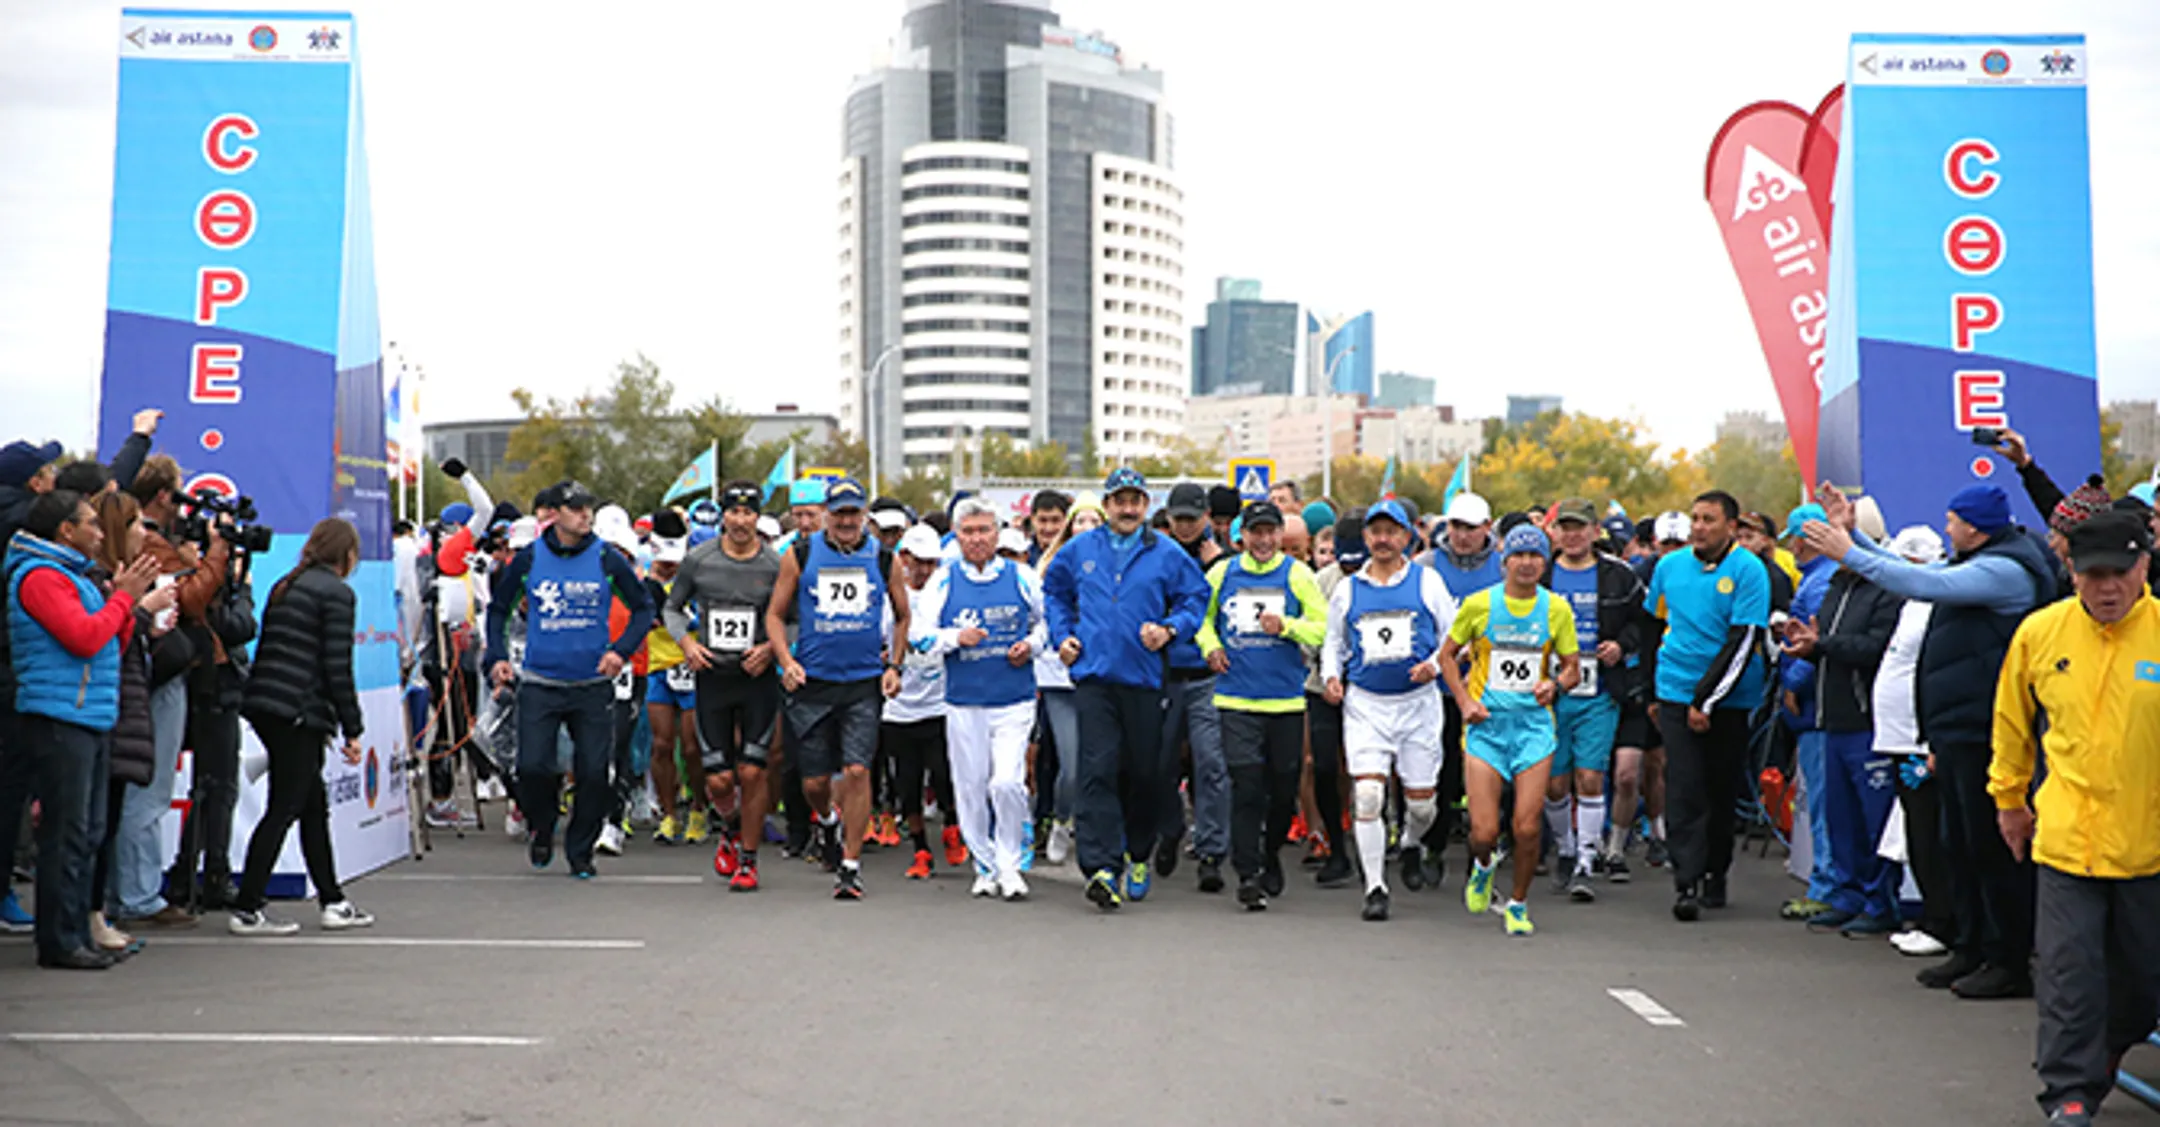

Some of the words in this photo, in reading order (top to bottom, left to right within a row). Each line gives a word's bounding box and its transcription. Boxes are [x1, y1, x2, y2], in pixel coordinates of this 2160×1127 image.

[149, 28, 172, 45] air
[177, 30, 234, 46] astana
[1883, 55, 1904, 71] air
[1909, 57, 1967, 72] astana
[1764, 216, 1817, 278] air
[830, 582, 858, 602] 70
[714, 617, 749, 639] 121
[1377, 626, 1392, 645] 9
[1500, 659, 1531, 680] 96
